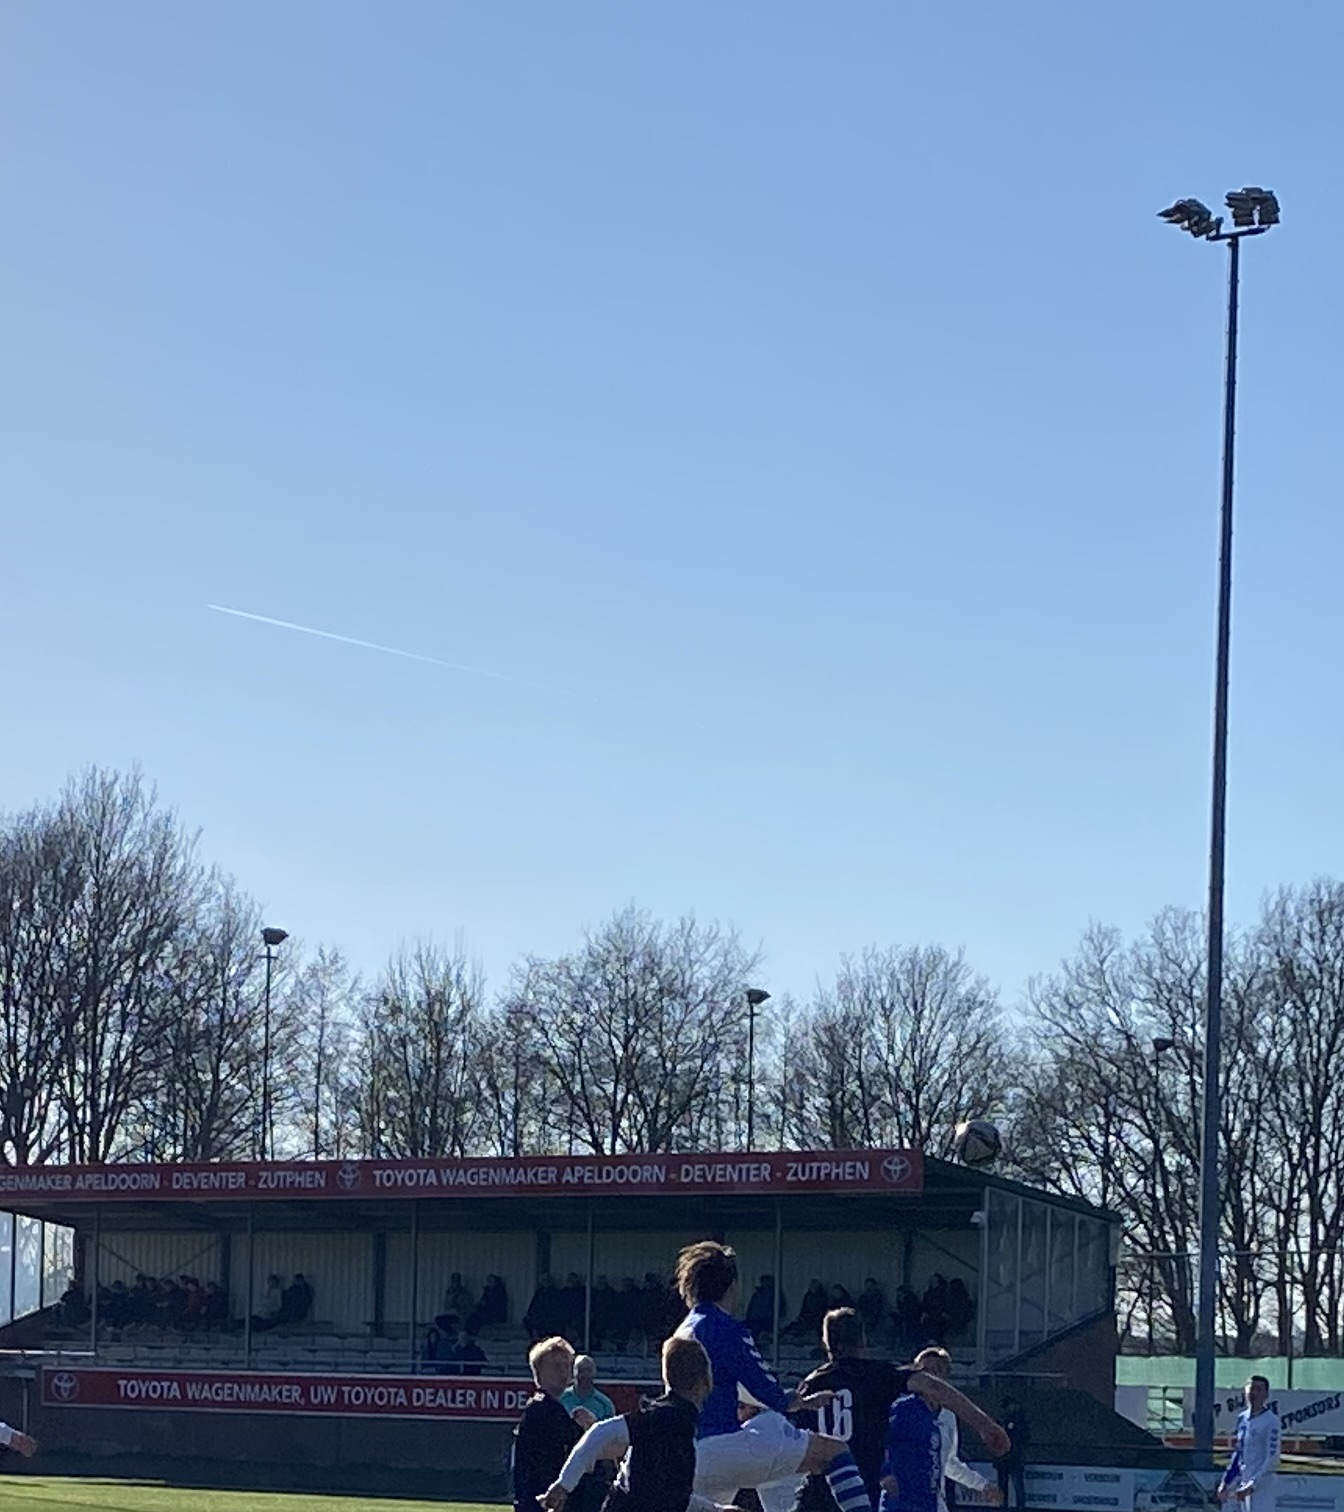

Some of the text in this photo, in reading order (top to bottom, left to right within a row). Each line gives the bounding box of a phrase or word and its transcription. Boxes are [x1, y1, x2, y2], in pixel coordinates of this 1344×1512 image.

[74, 1173, 160, 1190] APELDOORN
[171, 1171, 246, 1189] DEVENTER
[258, 1170, 326, 1189] ZUTPHEN
[373, 1160, 869, 1187] TOYOTA WAGENMAKER APELDOORN DEVENTER ZUTPHEN
[117, 1379, 181, 1400] TOYOTA
[310, 1385, 338, 1404] UW
[341, 1386, 408, 1407] TOYOTA
[412, 1388, 477, 1409] DEALER
[481, 1389, 499, 1409] IN
[1280, 1392, 1342, 1430] SPONSORS
